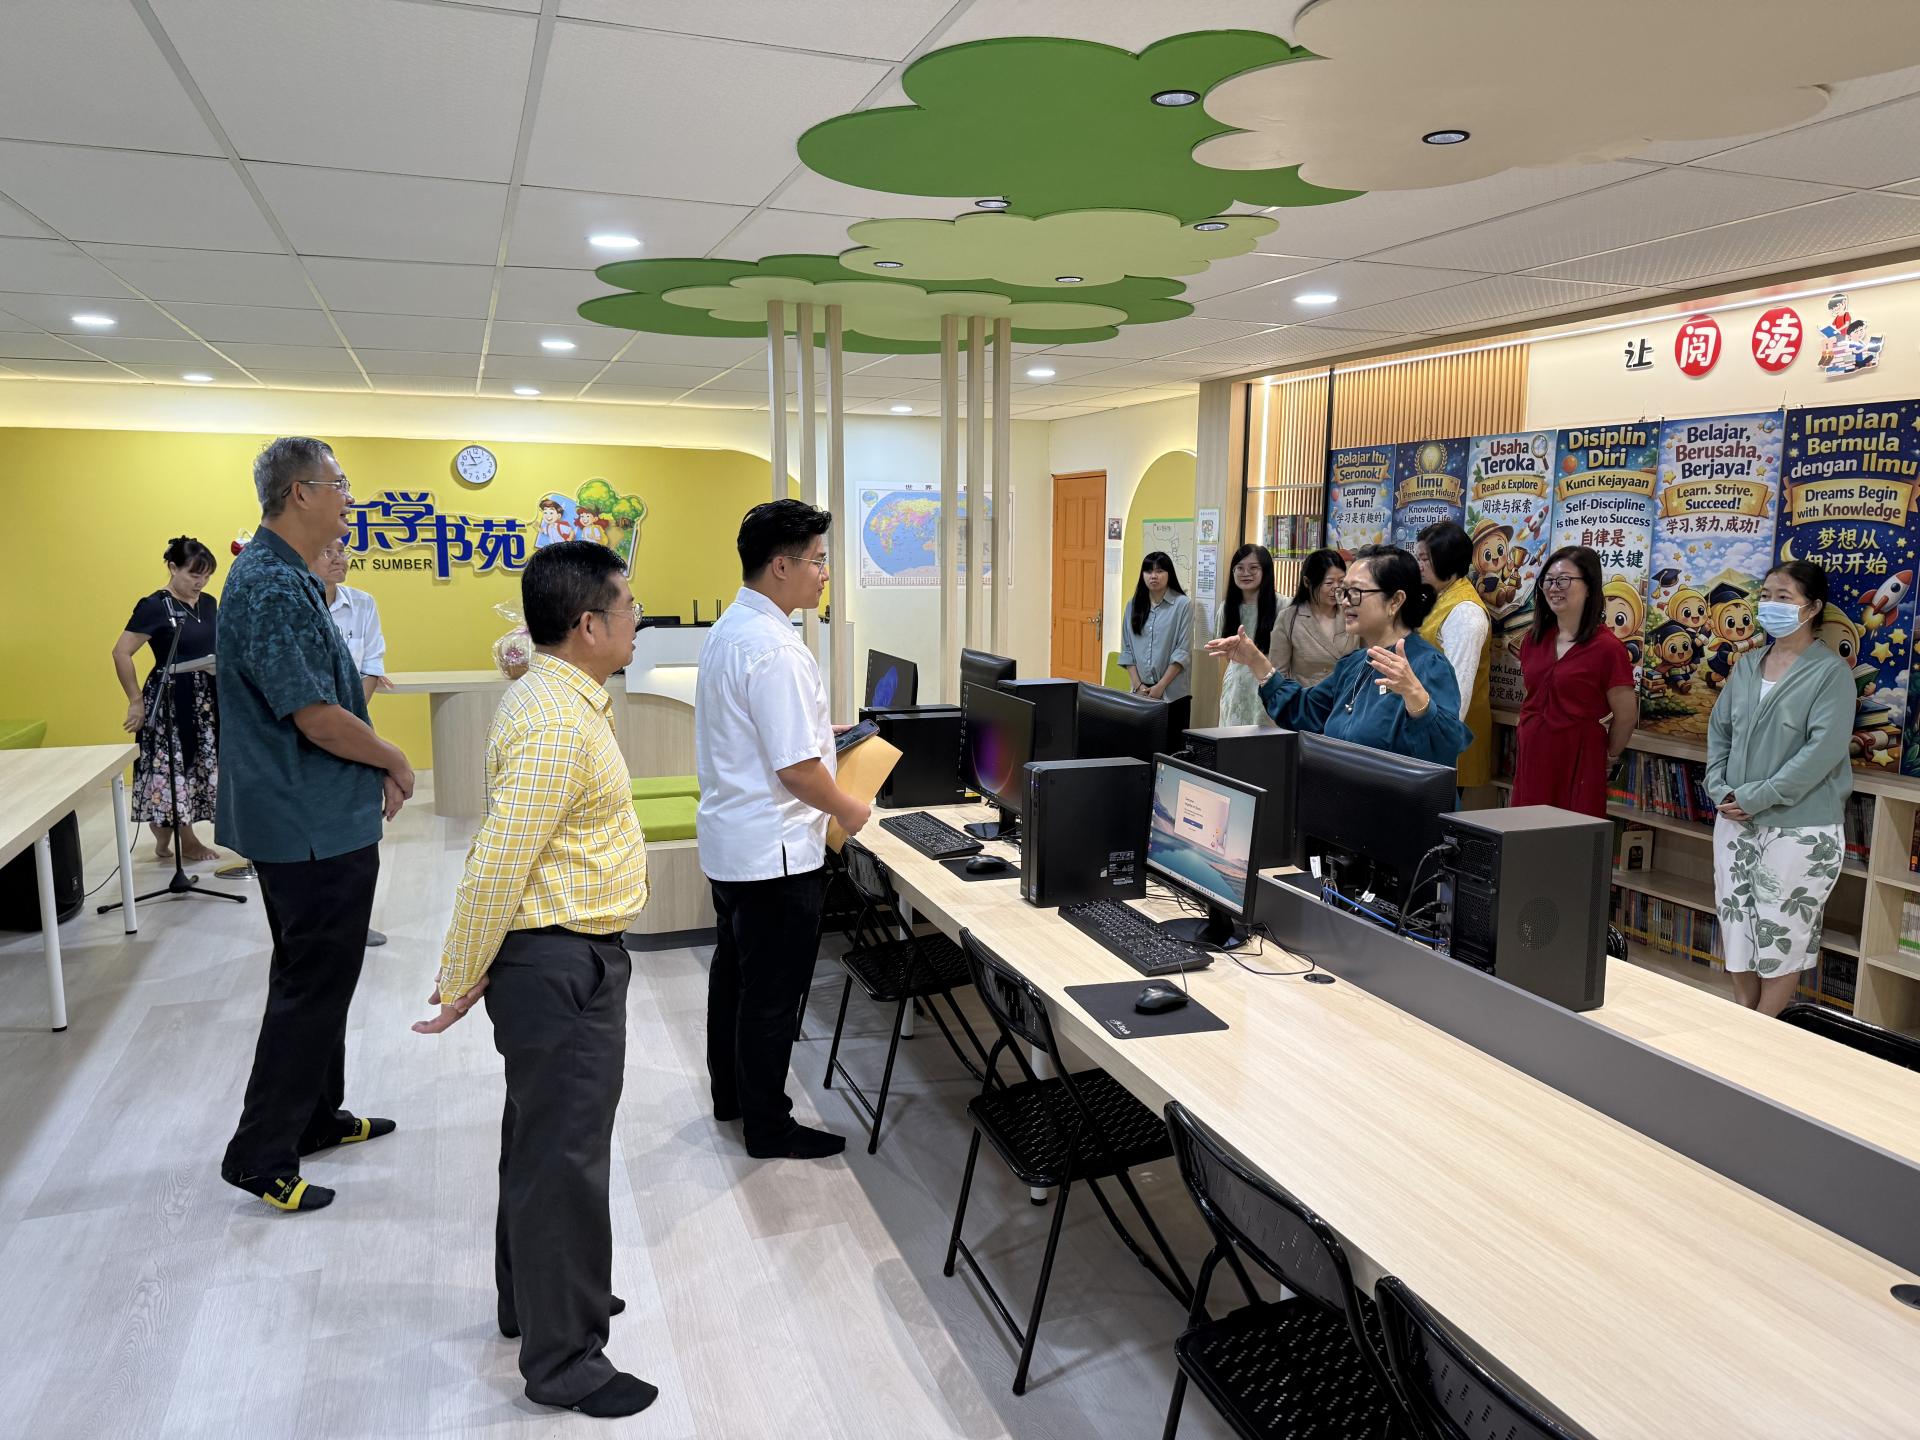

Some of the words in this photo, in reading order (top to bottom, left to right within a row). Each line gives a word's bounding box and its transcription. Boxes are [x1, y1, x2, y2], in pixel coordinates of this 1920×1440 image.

[1805, 408, 1899, 436] Impian
[1569, 426, 1646, 449] Disiplin
[1687, 423, 1751, 443] Belajar,
[1490, 439, 1529, 457] Usaha
[1675, 441, 1762, 462] Berusaha,
[1807, 432, 1900, 455] Bermula
[1337, 451, 1369, 467] Belajar
[1372, 450, 1386, 464] Itu
[1481, 454, 1535, 475] Teroka
[1588, 448, 1626, 468] Diri
[1791, 457, 1857, 478] dengan
[1862, 453, 1918, 475] Ilmu
[1340, 468, 1382, 480] Seronok!
[1681, 459, 1752, 479] Berjaya!
[1416, 476, 1443, 489] Ilmu
[1481, 480, 1500, 494] Read
[1508, 478, 1538, 491] Explore
[1566, 476, 1595, 491] Kunci
[1598, 475, 1649, 489] Kejayaan
[1343, 486, 1376, 497] Learning
[1403, 490, 1435, 499] Penerang
[1435, 488, 1456, 499] Hidup
[1677, 486, 1711, 498] Learn.
[1714, 484, 1753, 497] Strive.
[1805, 487, 1855, 502] Dreams
[1858, 485, 1898, 503] Begin
[1346, 499, 1352, 508] is
[1353, 497, 1373, 508] Fun!
[1408, 505, 1447, 514] Knowledge
[1482, 498, 1532, 513] 阅读与探索
[1565, 498, 1646, 513] Self-Discipline
[1685, 497, 1741, 510] Succeed!
[1797, 507, 1819, 518] with
[1823, 502, 1901, 521] Knowledge
[1405, 515, 1425, 525] Lights
[1426, 515, 1436, 524] Up
[1438, 515, 1451, 523] Life
[1556, 520, 1563, 528] is
[1565, 517, 1579, 527] the
[1581, 515, 1597, 526] Key
[1599, 515, 1608, 524] to
[1610, 513, 1651, 527] Success
[1581, 528, 1626, 547] 自律是
[1817, 527, 1880, 549] 梦想从
[373, 559, 433, 570] SUMBER
[1597, 550, 1644, 568] 的关键
[1490, 664, 1502, 673] ork
[1489, 676, 1516, 687] uccess!
